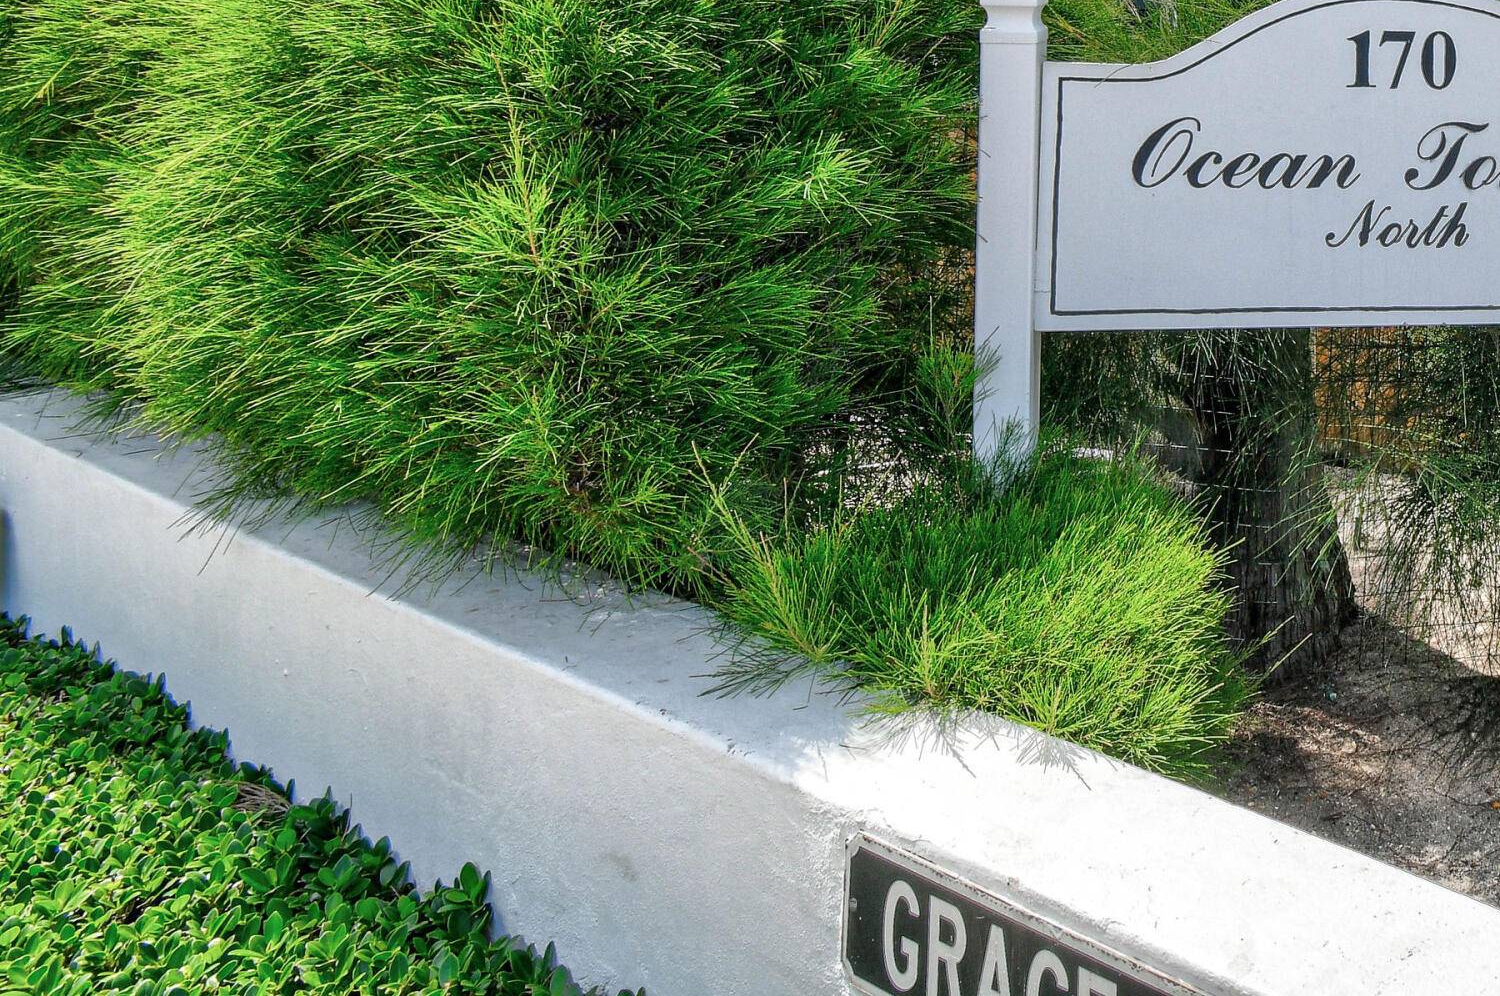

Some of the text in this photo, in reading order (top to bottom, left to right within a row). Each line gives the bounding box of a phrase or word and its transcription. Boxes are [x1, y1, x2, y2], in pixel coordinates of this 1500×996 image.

[1346, 30, 1457, 90] 170
[1131, 116, 1361, 190] Ocean
[1325, 199, 1470, 249] North
[882, 880, 1118, 996] GRA
